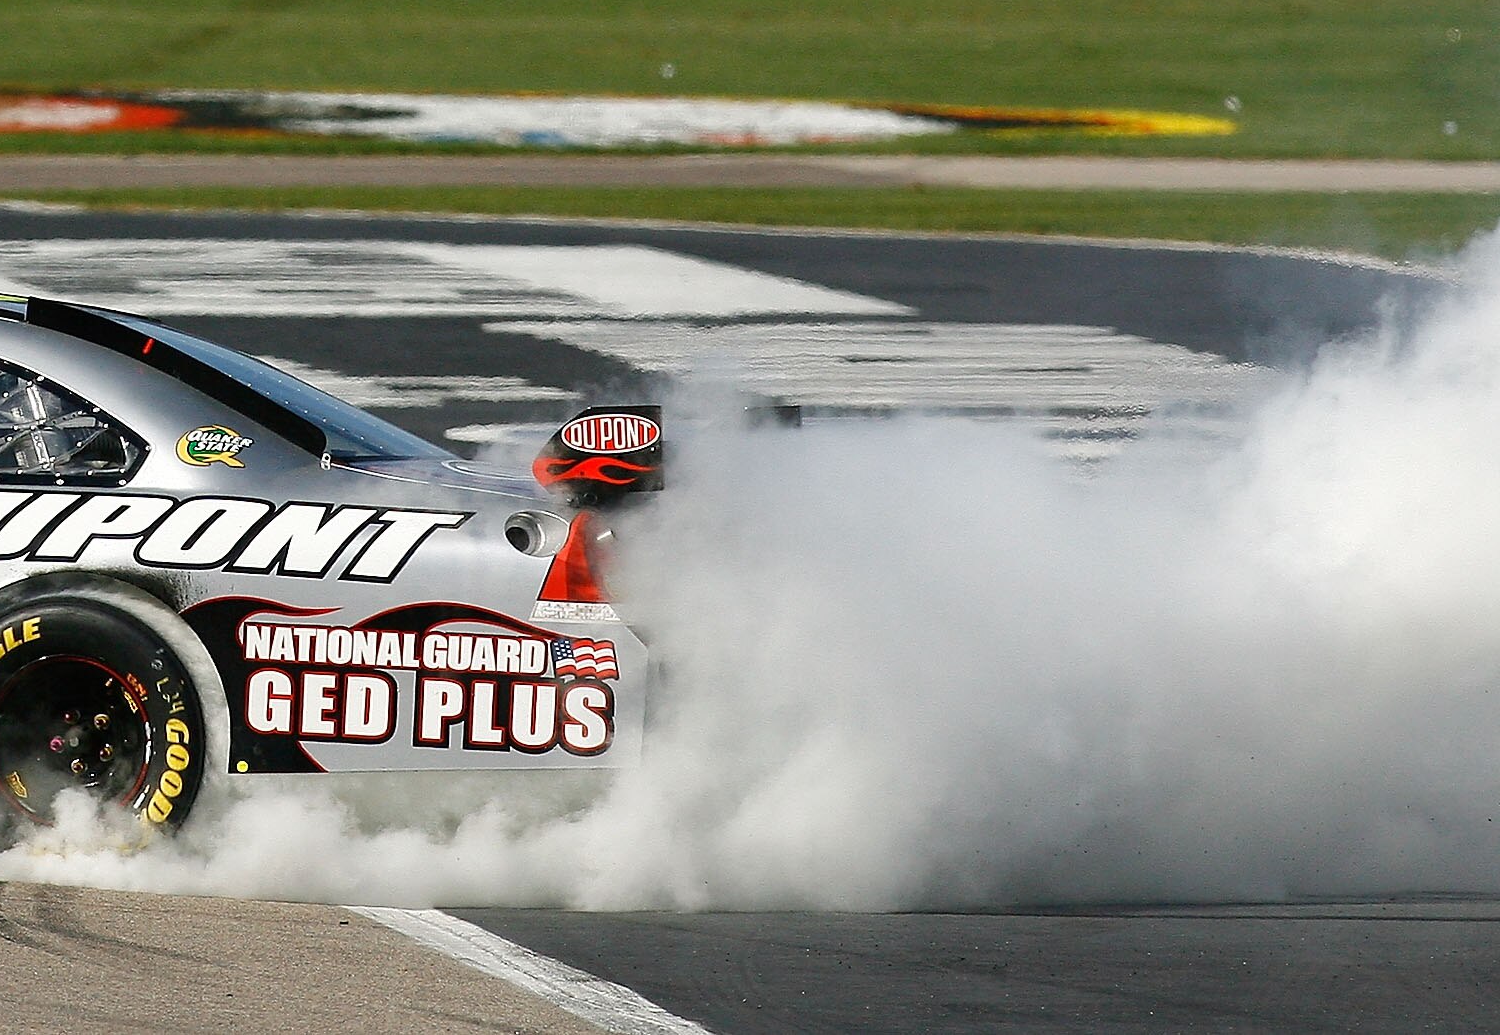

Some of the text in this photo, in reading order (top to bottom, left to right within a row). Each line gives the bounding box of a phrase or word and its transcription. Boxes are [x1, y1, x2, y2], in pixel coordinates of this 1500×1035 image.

[187, 430, 253, 447] QUAKER
[194, 441, 239, 453] STATE
[245, 626, 547, 674] NATIONAL GUARD
[247, 670, 608, 749] GED PLUS
